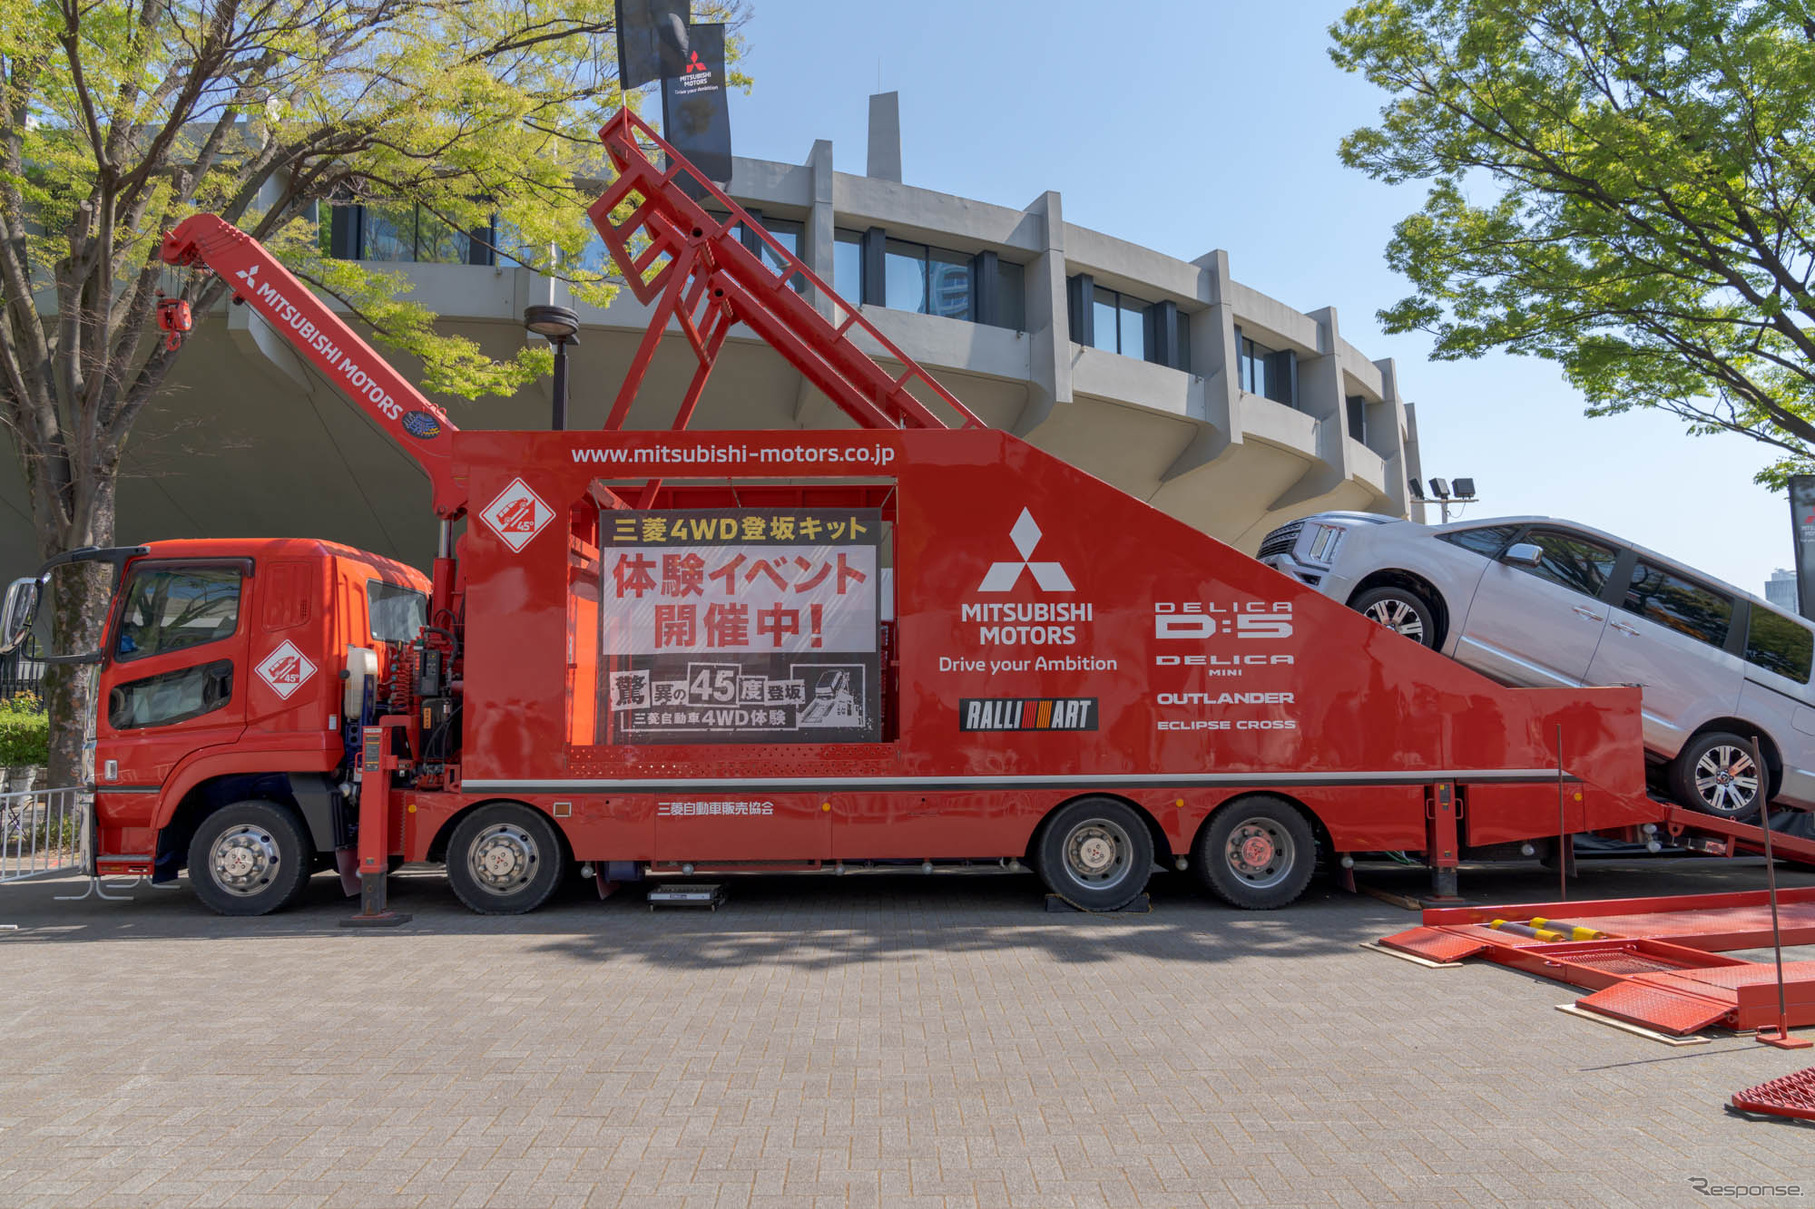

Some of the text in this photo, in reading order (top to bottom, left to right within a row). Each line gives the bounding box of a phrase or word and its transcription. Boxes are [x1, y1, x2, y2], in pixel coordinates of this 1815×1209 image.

[680, 72, 711, 82] MITSUBISHI
[684, 78, 708, 87] MOTORS
[256, 282, 404, 421] MITSUBISHI MOTORS
[571, 443, 896, 466] www.mitsubishi-motors.co.jp
[612, 515, 868, 542] 三菱4WD登坂キット
[612, 552, 867, 599] 体験イベント
[961, 602, 1093, 622] MITSUBISHI
[1154, 601, 1293, 613] DELICA
[979, 625, 1076, 645] MOTORS
[1154, 614, 1293, 640] D:5
[939, 656, 1118, 676] Drive your Ambition
[1155, 655, 1295, 666] DELICA
[1208, 669, 1243, 677] MINI
[1156, 692, 1295, 705] OUTLANDER
[1157, 720, 1297, 730] ECLIPSE CROSS
[657, 801, 774, 816] 三菱自動車販売協会
